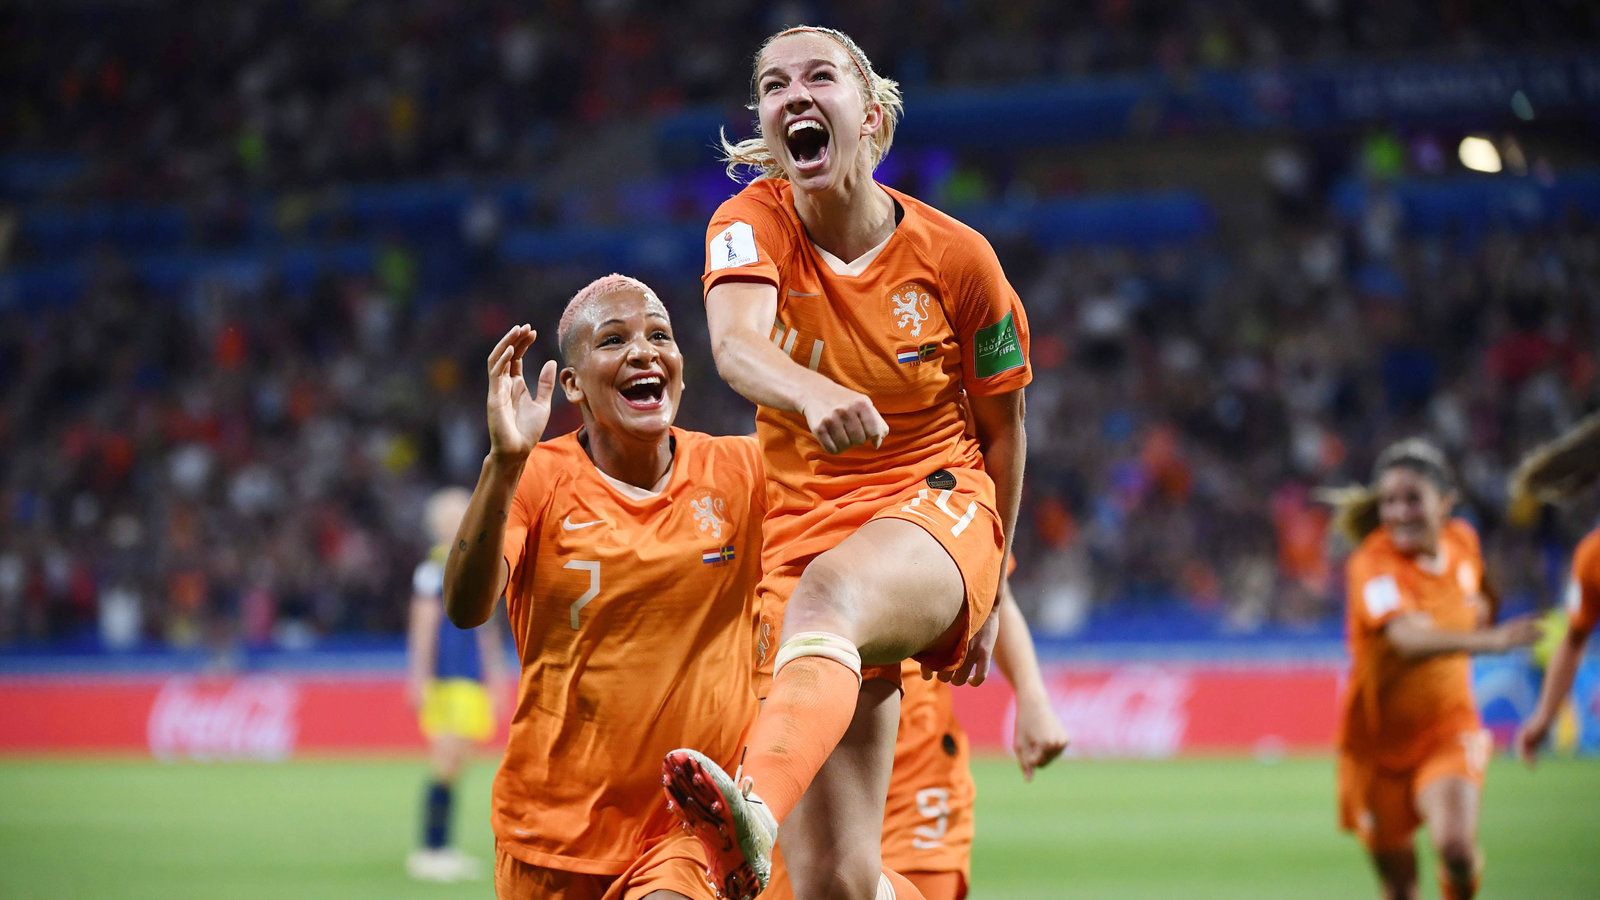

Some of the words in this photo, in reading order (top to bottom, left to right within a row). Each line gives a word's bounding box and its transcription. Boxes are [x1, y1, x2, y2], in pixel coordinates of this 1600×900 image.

[999, 344, 1016, 357] FIFA
[562, 559, 601, 630] 7
[912, 786, 951, 841] 9
